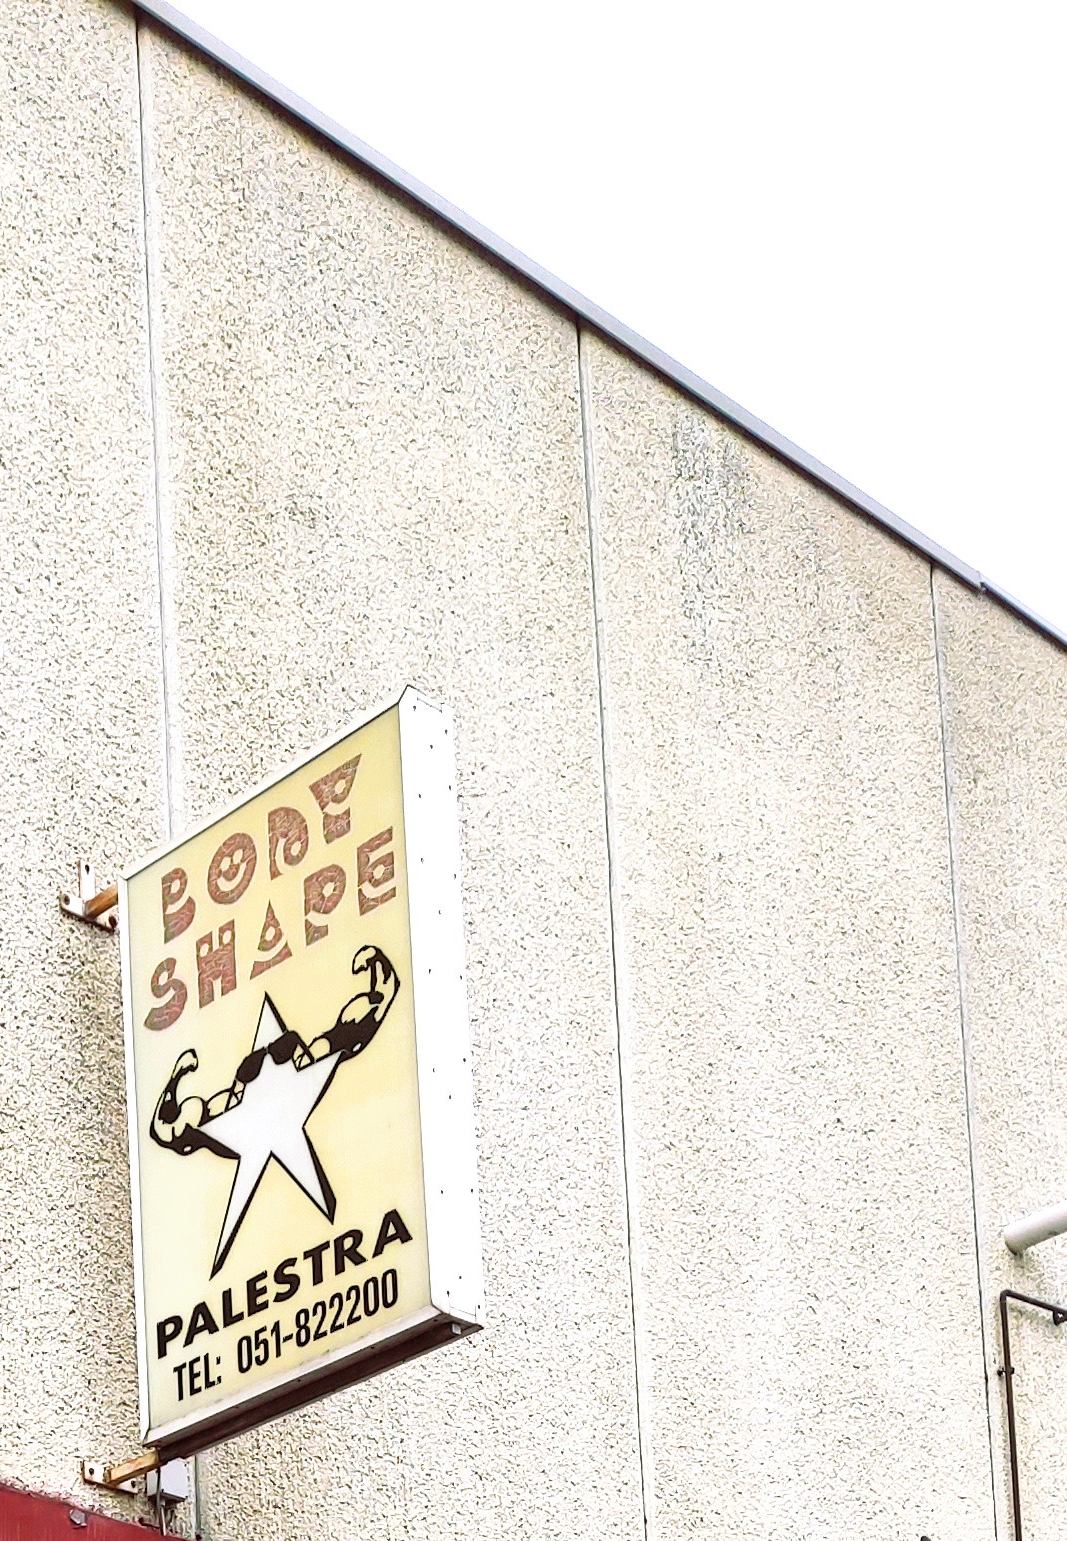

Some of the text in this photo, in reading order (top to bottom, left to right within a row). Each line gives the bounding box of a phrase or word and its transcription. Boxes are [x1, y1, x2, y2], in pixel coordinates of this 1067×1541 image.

[143, 825, 397, 1031] SHAPE
[161, 753, 362, 944] BODY
[156, 1208, 413, 1359] PALESTRA
[173, 1268, 399, 1401] TEL: 051-822200
